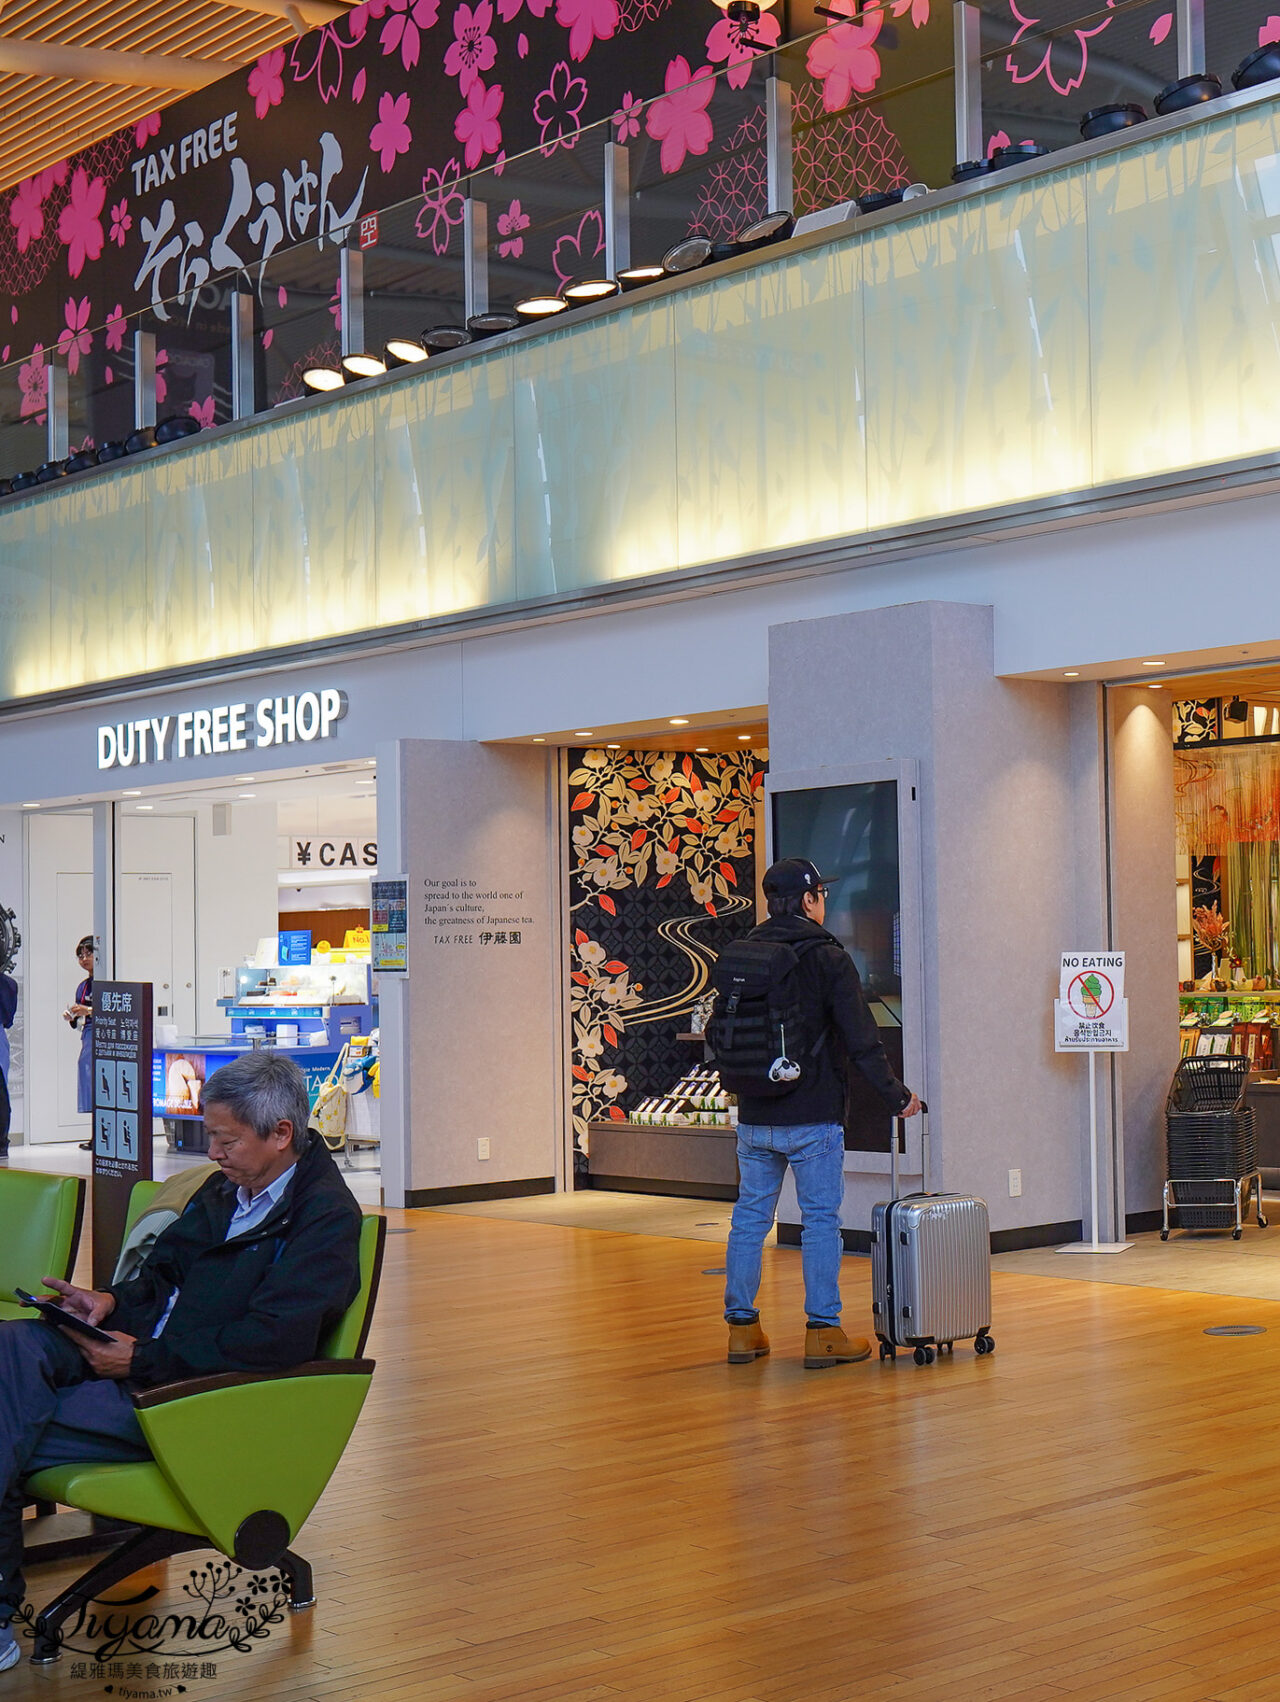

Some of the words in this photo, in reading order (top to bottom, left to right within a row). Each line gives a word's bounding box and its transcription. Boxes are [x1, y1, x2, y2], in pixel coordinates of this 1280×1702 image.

[131, 144, 176, 196] TAX
[180, 112, 238, 174] FREE
[98, 716, 170, 769] DUTY
[178, 703, 247, 757] FREE
[256, 689, 342, 747] SHOP
[424, 879, 439, 887] Our
[441, 879, 458, 889] goal
[460, 879, 467, 887] is
[424, 891, 450, 902] spread
[451, 892, 460, 900] to
[461, 891, 473, 900] the
[475, 891, 498, 900] world
[514, 891, 524, 900] of
[455, 903, 485, 913] culture,
[424, 917, 437, 925] the
[438, 917, 475, 927] greatness
[476, 916, 485, 925] of
[486, 916, 520, 926] Japanese
[433, 935, 450, 944] TAX
[453, 935, 473, 944] FREE
[479, 931, 522, 945] 伊藤園
[1062, 957, 1079, 968] NO
[1082, 957, 1123, 968] EATING
[101, 991, 133, 1013] 優先席
